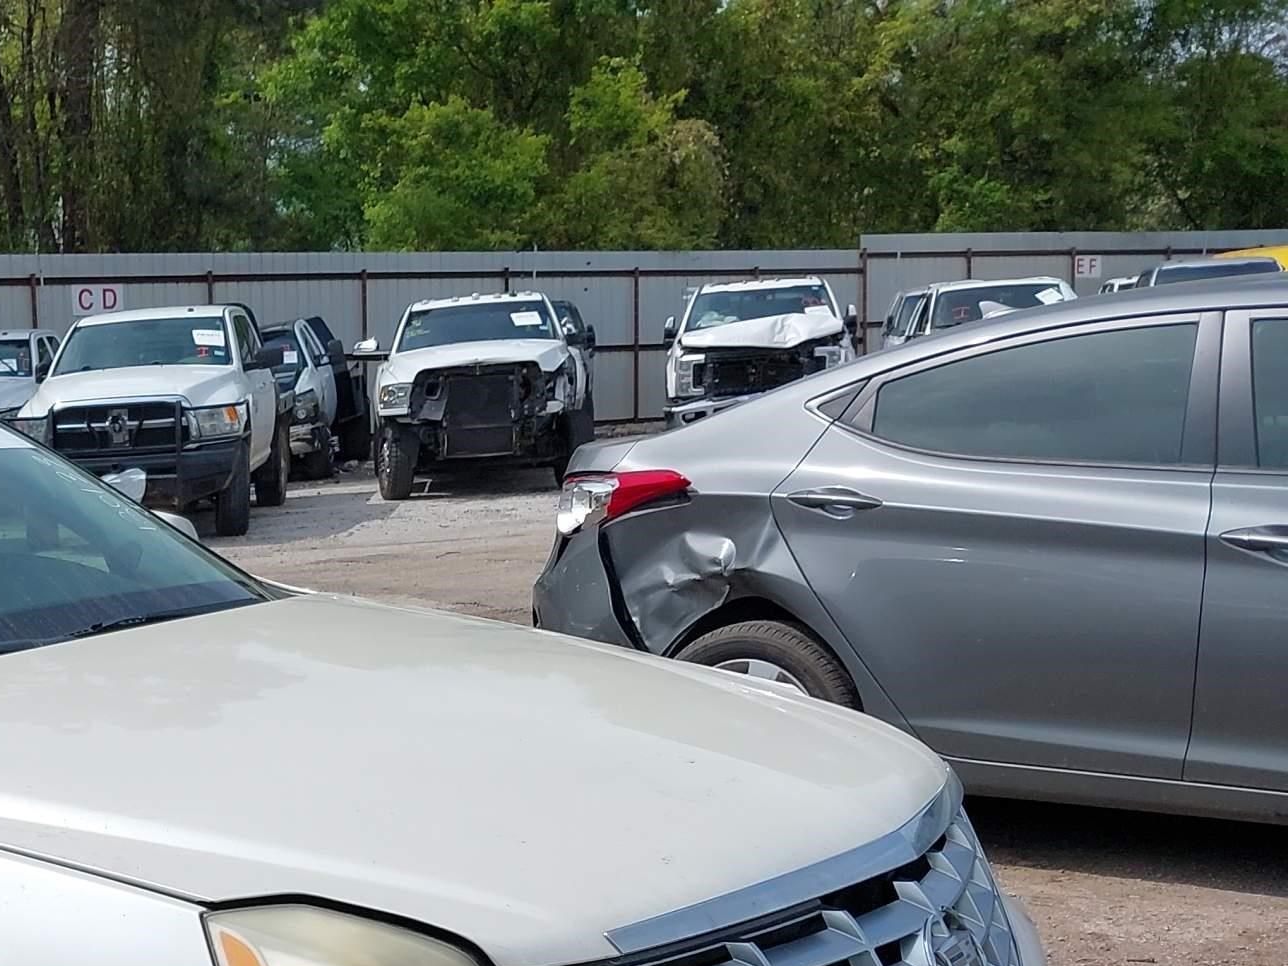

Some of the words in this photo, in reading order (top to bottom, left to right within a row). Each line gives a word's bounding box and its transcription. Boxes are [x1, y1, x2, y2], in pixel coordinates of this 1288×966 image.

[1077, 258, 1085, 274] E
[1089, 258, 1097, 274] F
[78, 288, 93, 310] C
[102, 288, 117, 310] D
